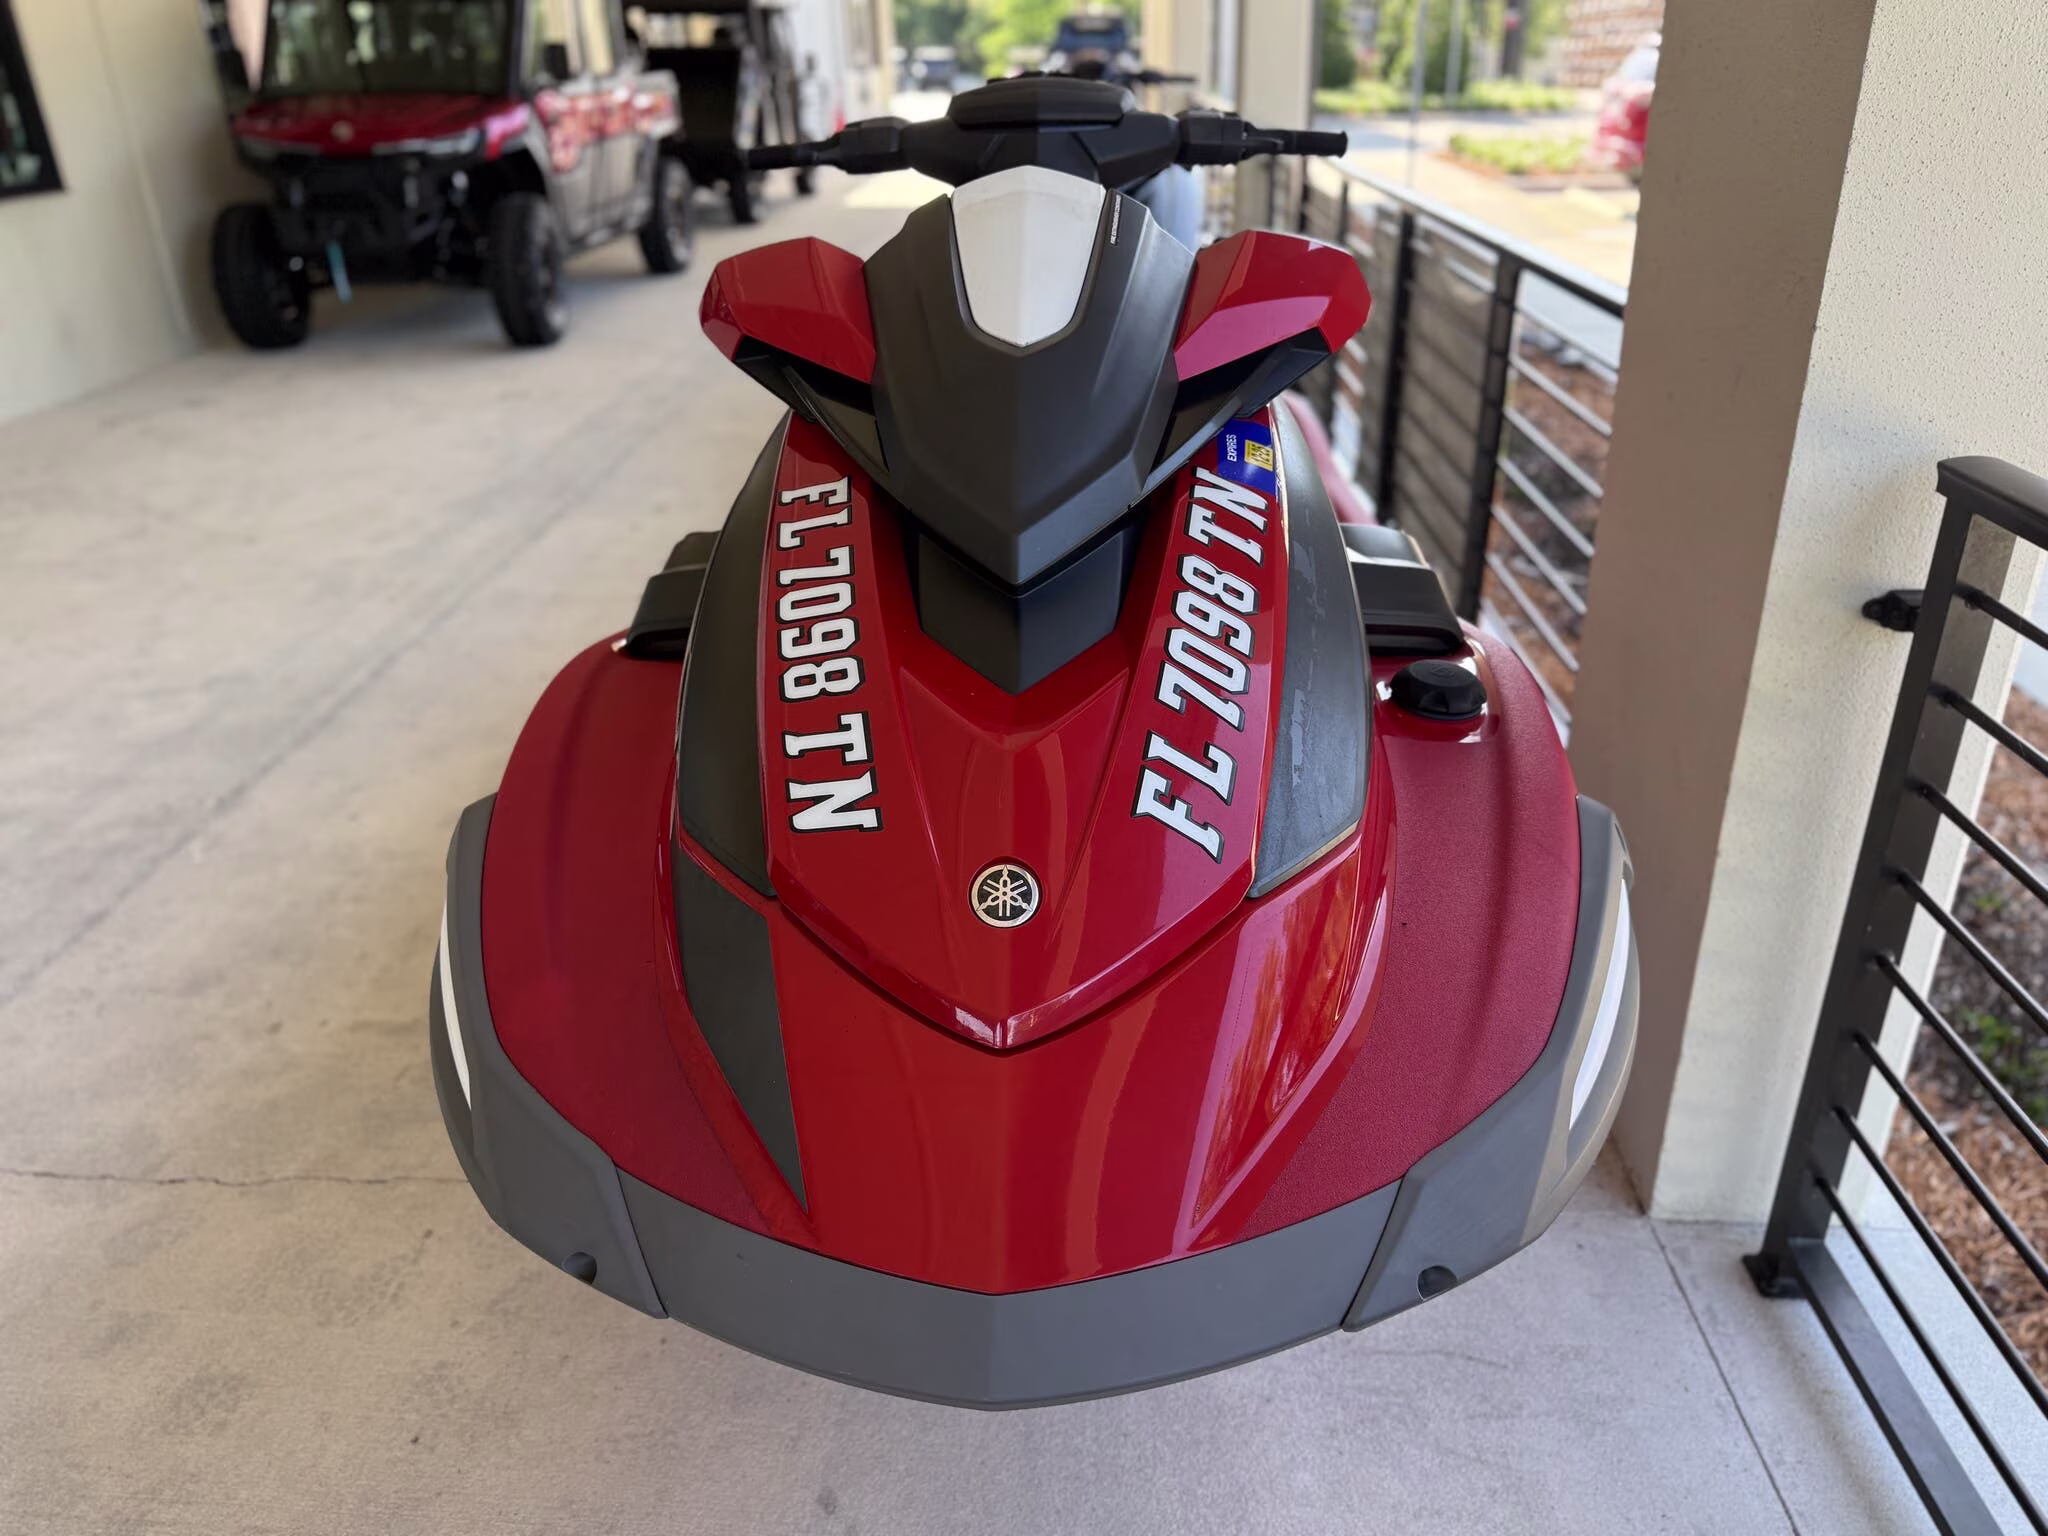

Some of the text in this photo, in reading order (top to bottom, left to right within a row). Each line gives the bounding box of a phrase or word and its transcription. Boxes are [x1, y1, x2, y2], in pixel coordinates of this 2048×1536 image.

[1226, 433, 1237, 462] EXPIRES
[777, 476, 883, 832] FL 7098 TN
[1132, 466, 1269, 864] FL 7098 TN
